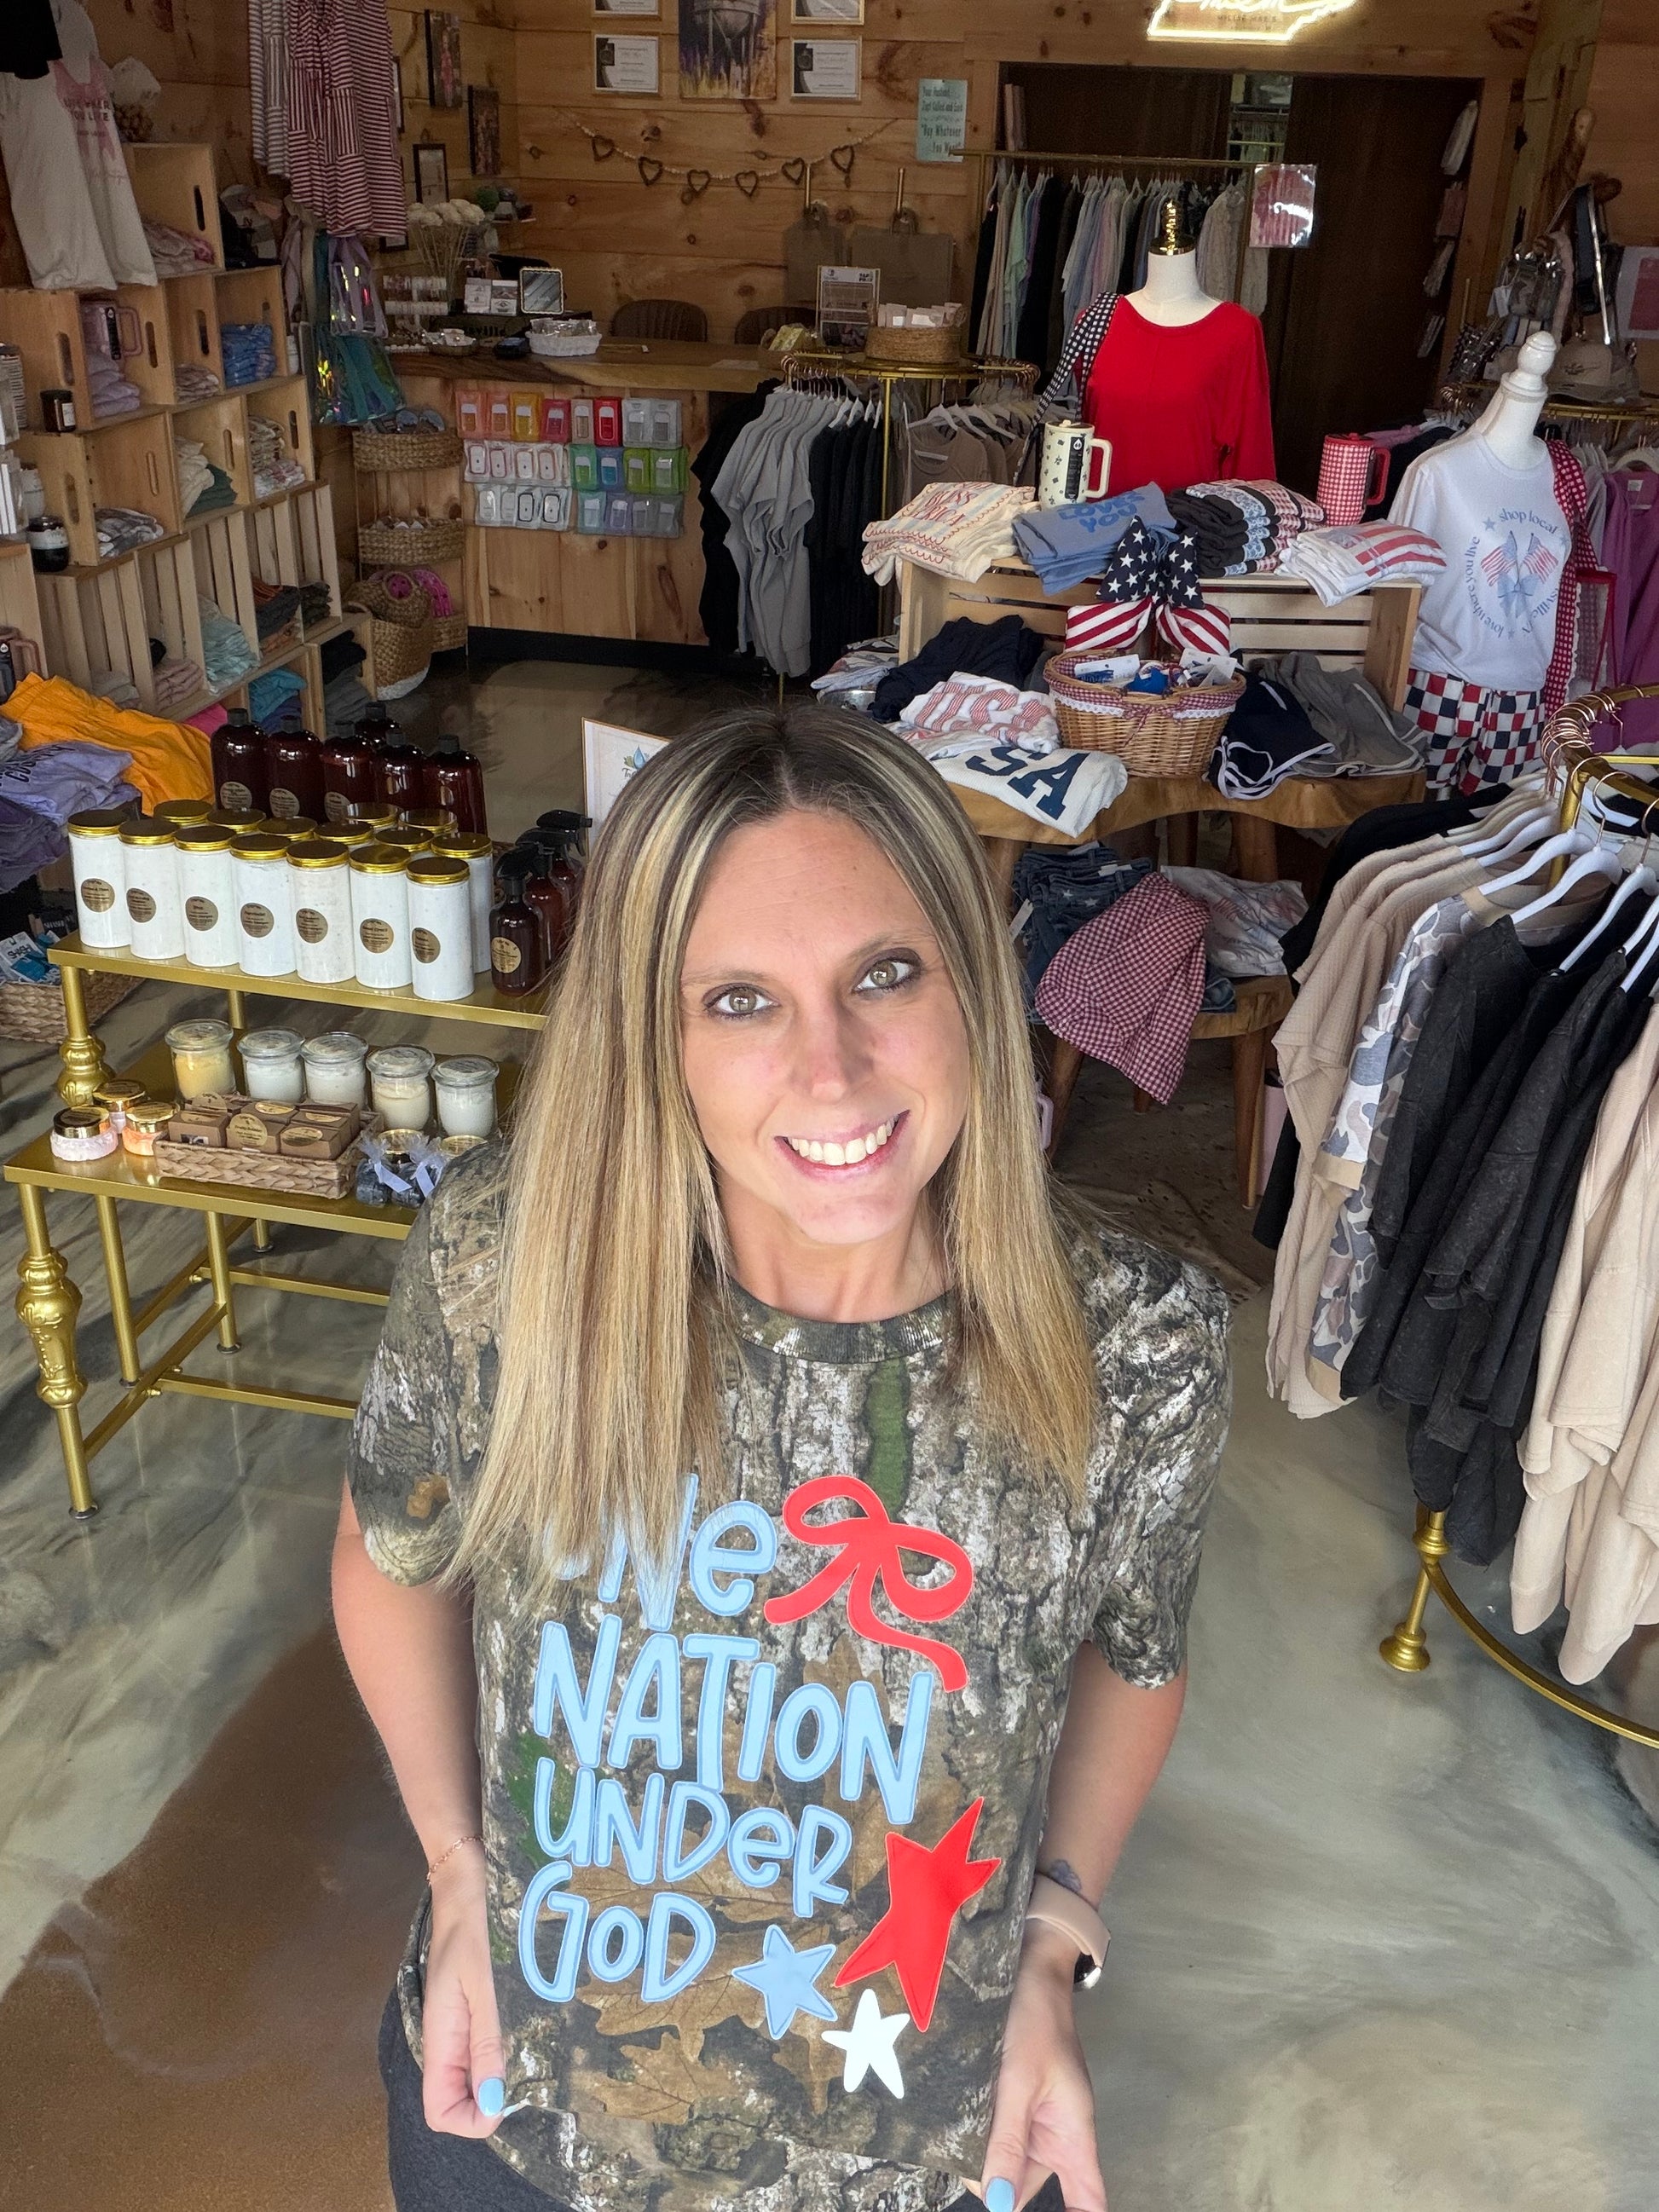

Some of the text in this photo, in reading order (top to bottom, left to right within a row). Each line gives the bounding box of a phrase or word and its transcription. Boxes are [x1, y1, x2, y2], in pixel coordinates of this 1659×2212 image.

[1078, 503, 1137, 533] YOU
[1499, 507, 1558, 534] shop local
[1464, 536, 1505, 638] love where you live
[965, 746, 1091, 821] SA
[541, 1472, 777, 1632] Ne
